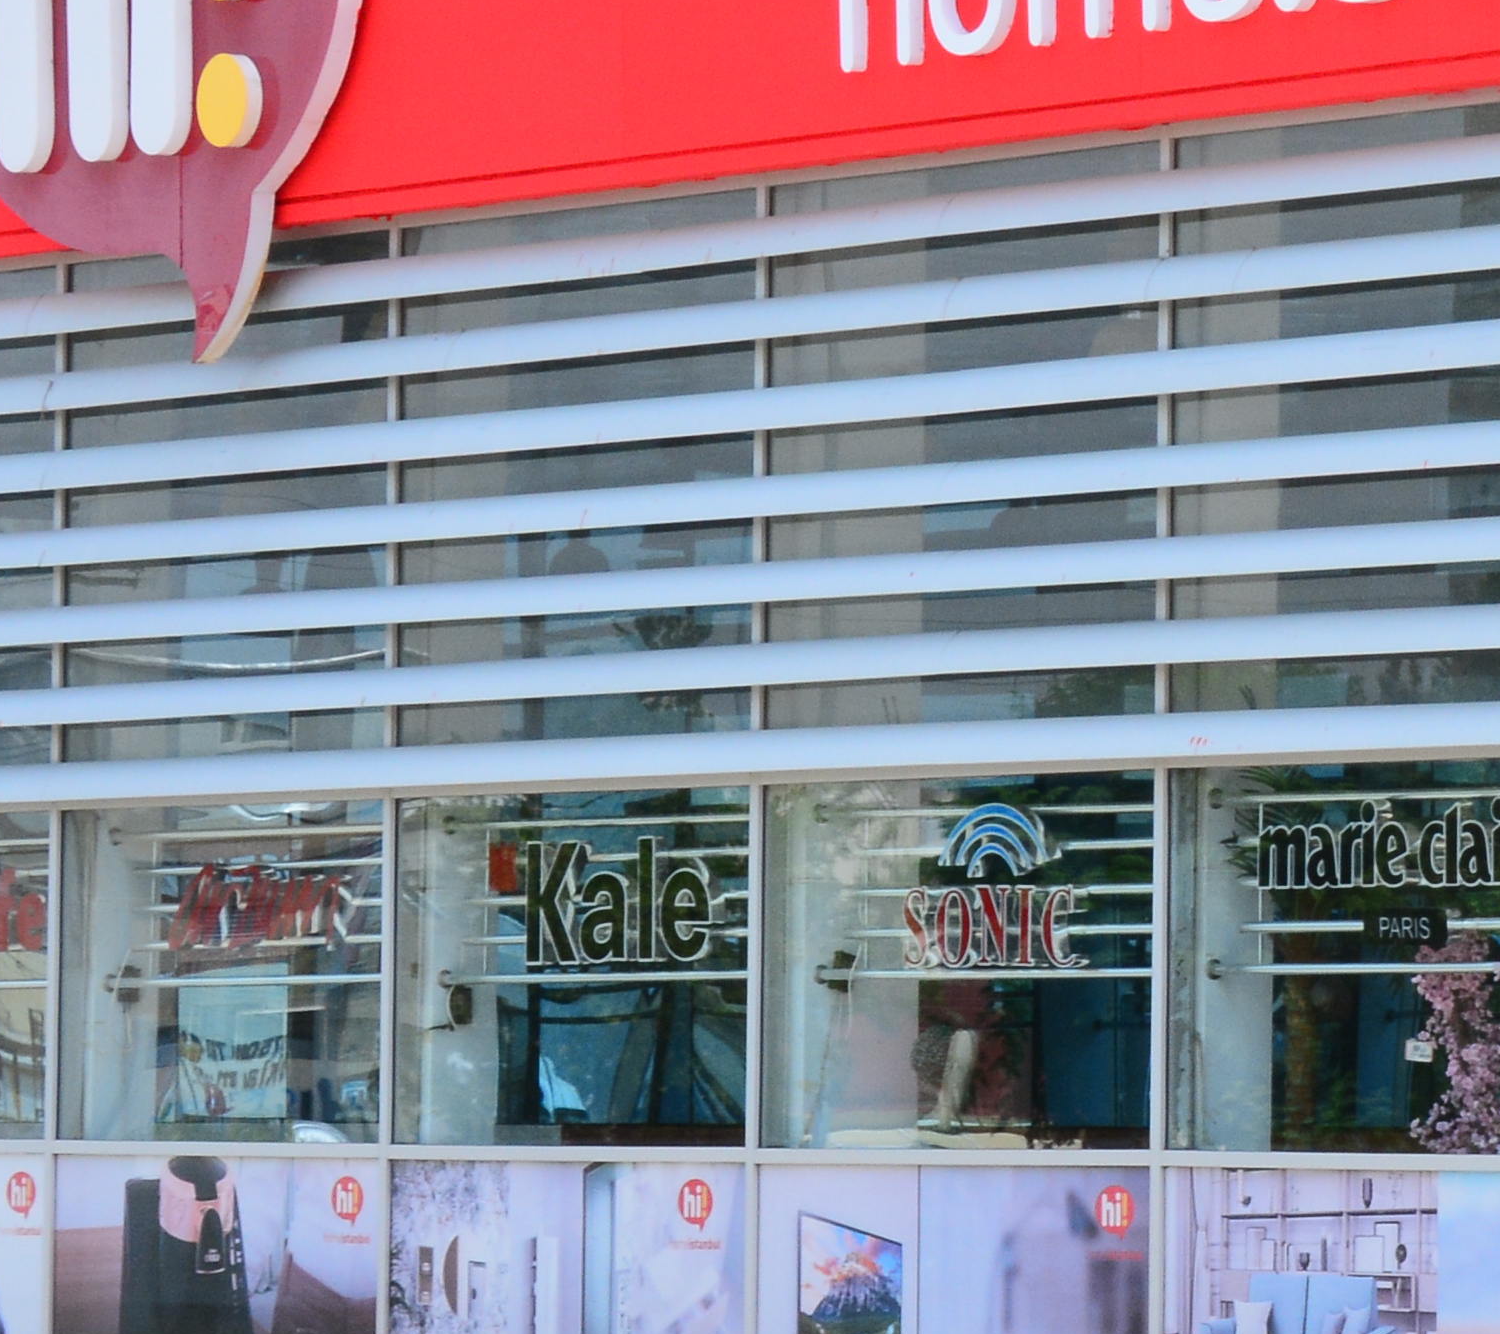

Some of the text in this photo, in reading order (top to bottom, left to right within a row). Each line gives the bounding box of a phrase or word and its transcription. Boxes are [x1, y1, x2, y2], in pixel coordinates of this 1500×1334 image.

[1257, 798, 1410, 889] marie
[526, 835, 713, 966] Kale
[903, 883, 1075, 967] SONIC
[1378, 916, 1431, 939] PARIS
[336, 1181, 359, 1214] hi!
[683, 1184, 708, 1219] hi!
[1101, 1192, 1128, 1228] hi!
